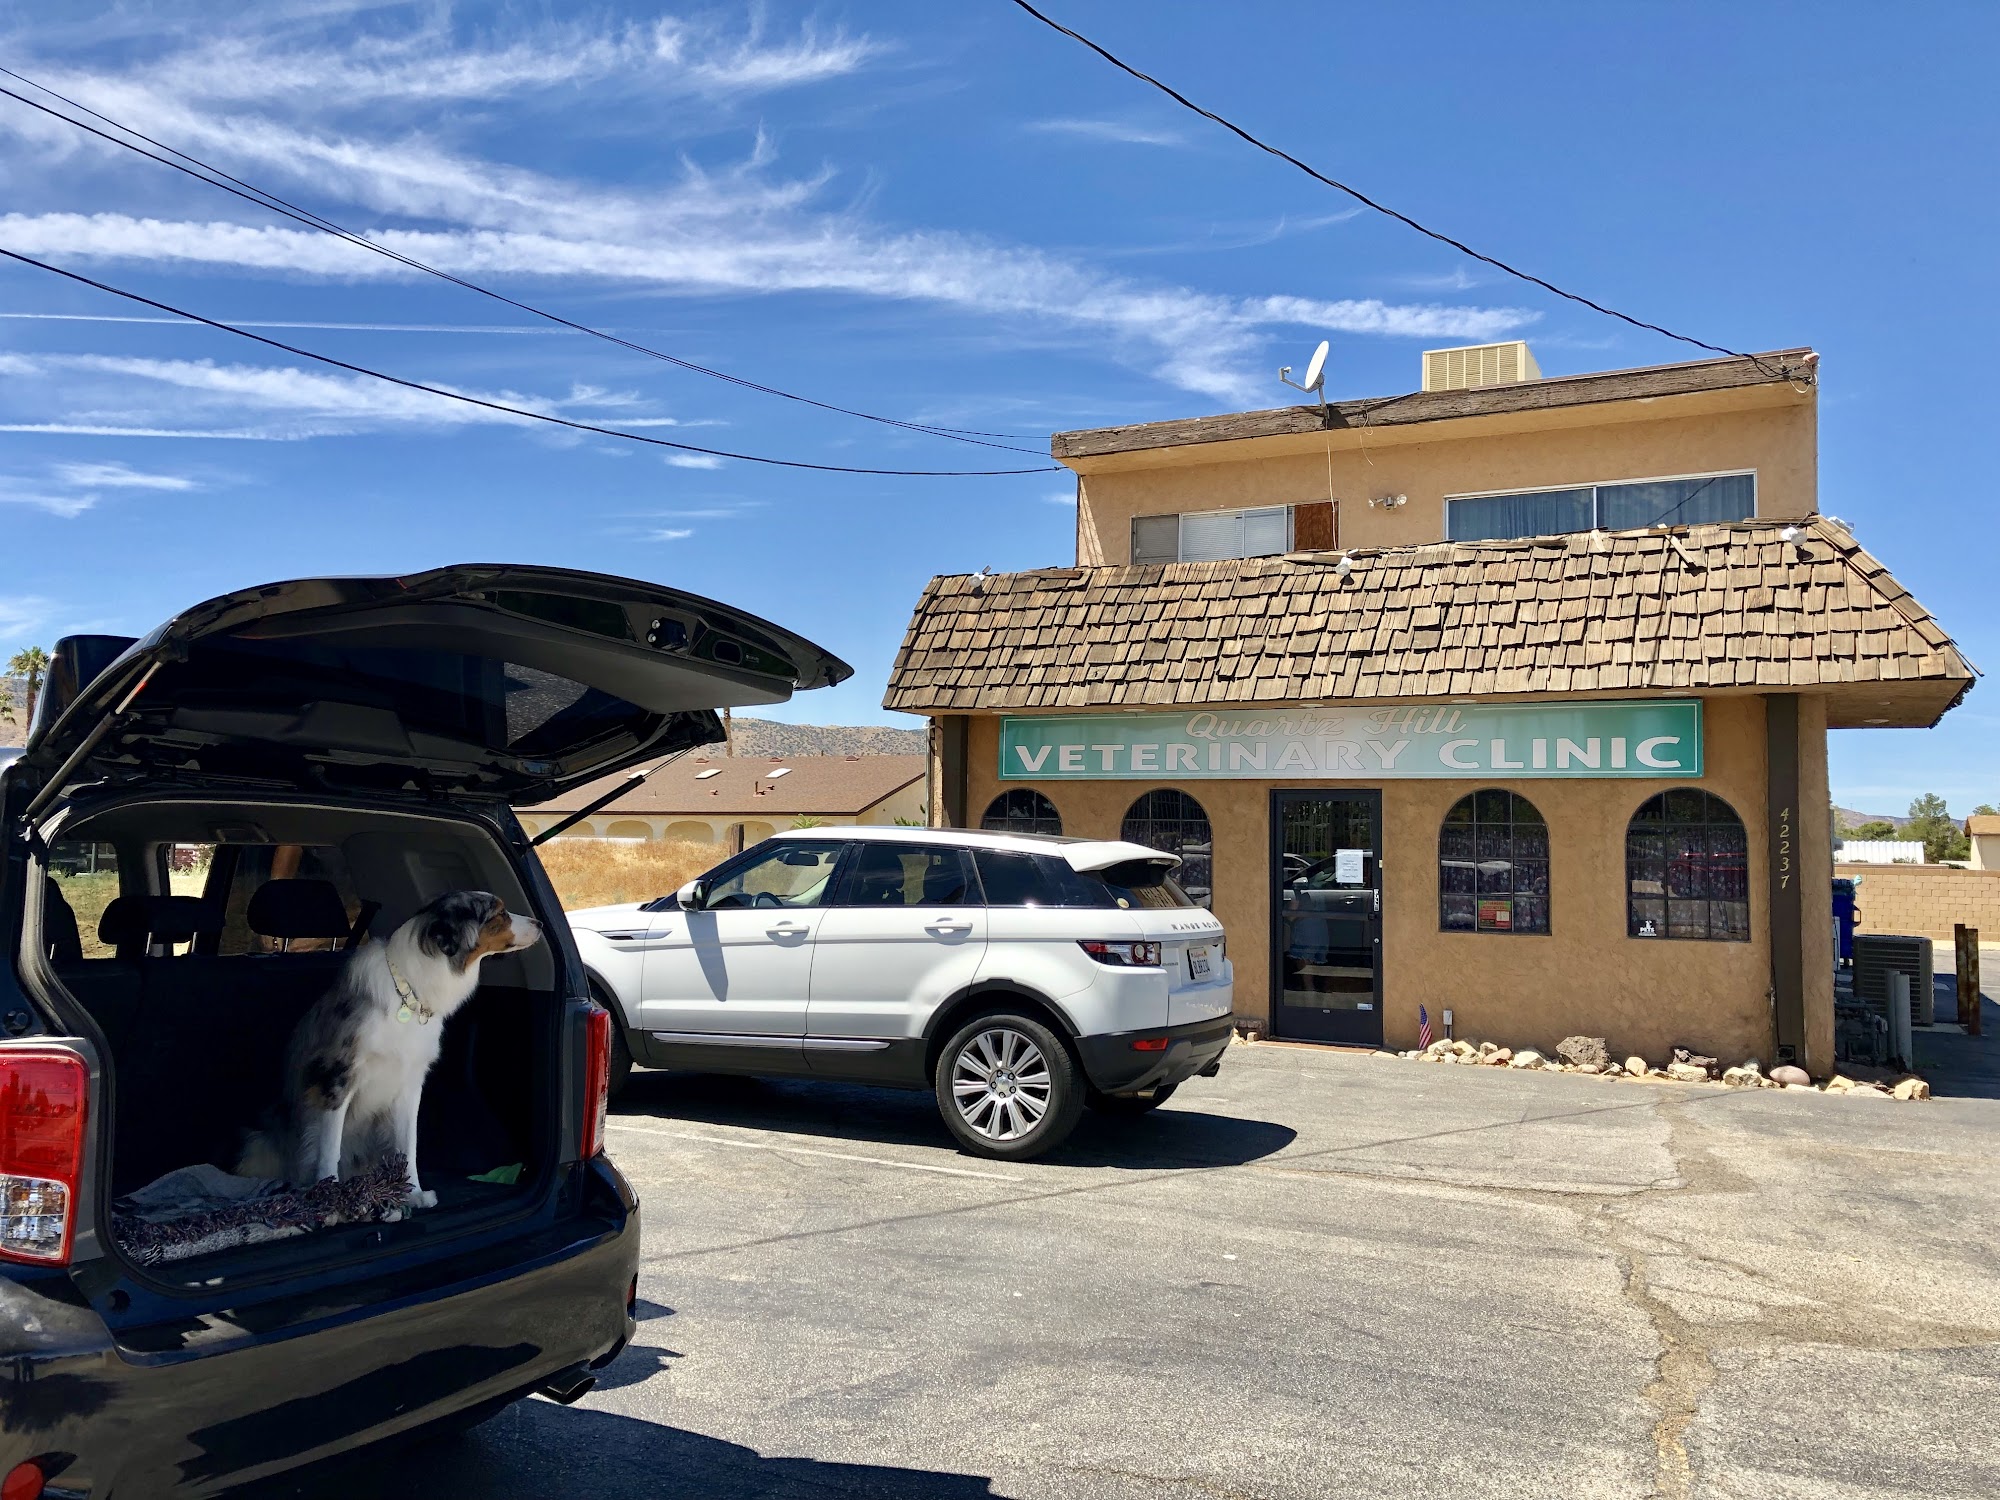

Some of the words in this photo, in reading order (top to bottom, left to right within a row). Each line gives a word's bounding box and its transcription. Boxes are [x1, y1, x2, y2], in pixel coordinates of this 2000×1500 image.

[1185, 712, 1344, 741] Quartz
[1363, 706, 1467, 735] Hill
[1015, 740, 1411, 772] VETERINARY
[1438, 737, 1681, 769] CLINIC
[1779, 807, 1790, 889] 42237
